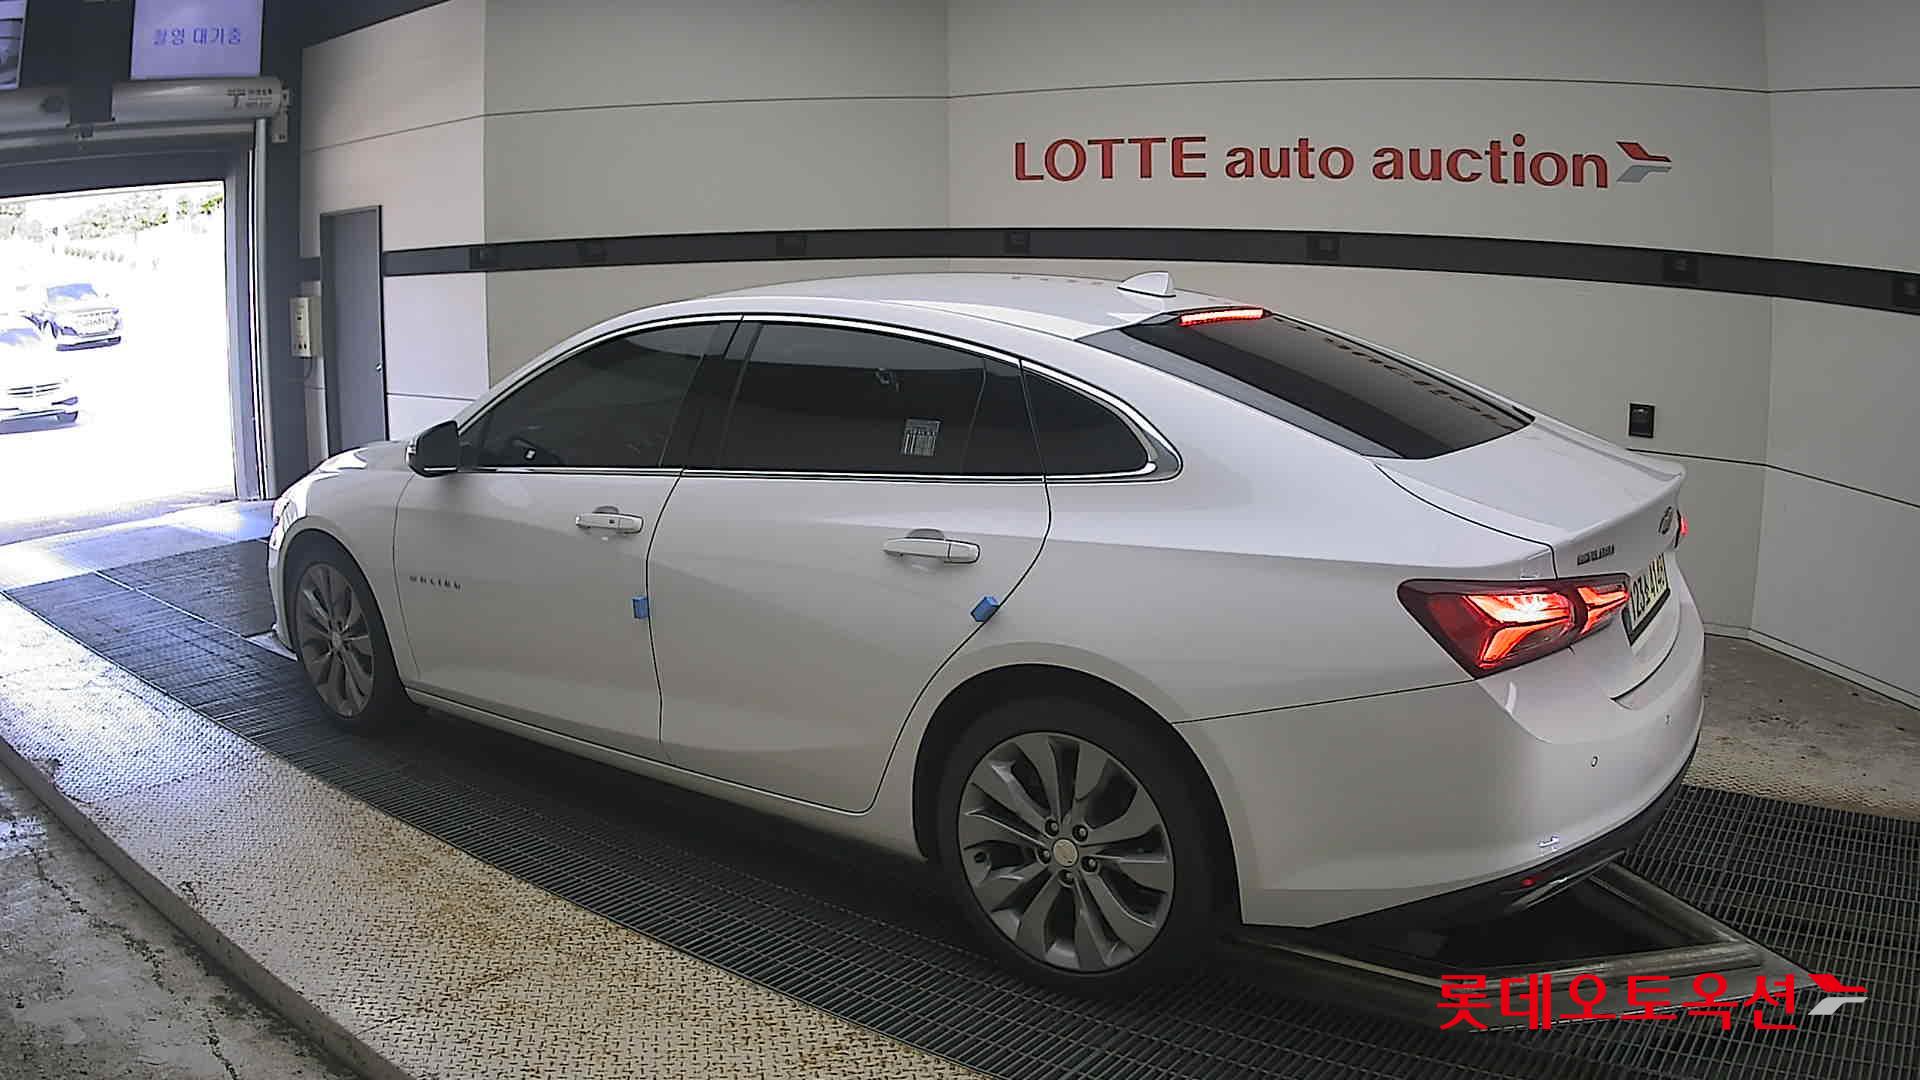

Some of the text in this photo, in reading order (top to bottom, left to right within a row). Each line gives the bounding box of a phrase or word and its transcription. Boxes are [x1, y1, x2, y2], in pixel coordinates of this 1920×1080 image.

[1014, 133, 1610, 188] LOTTE auto auction
